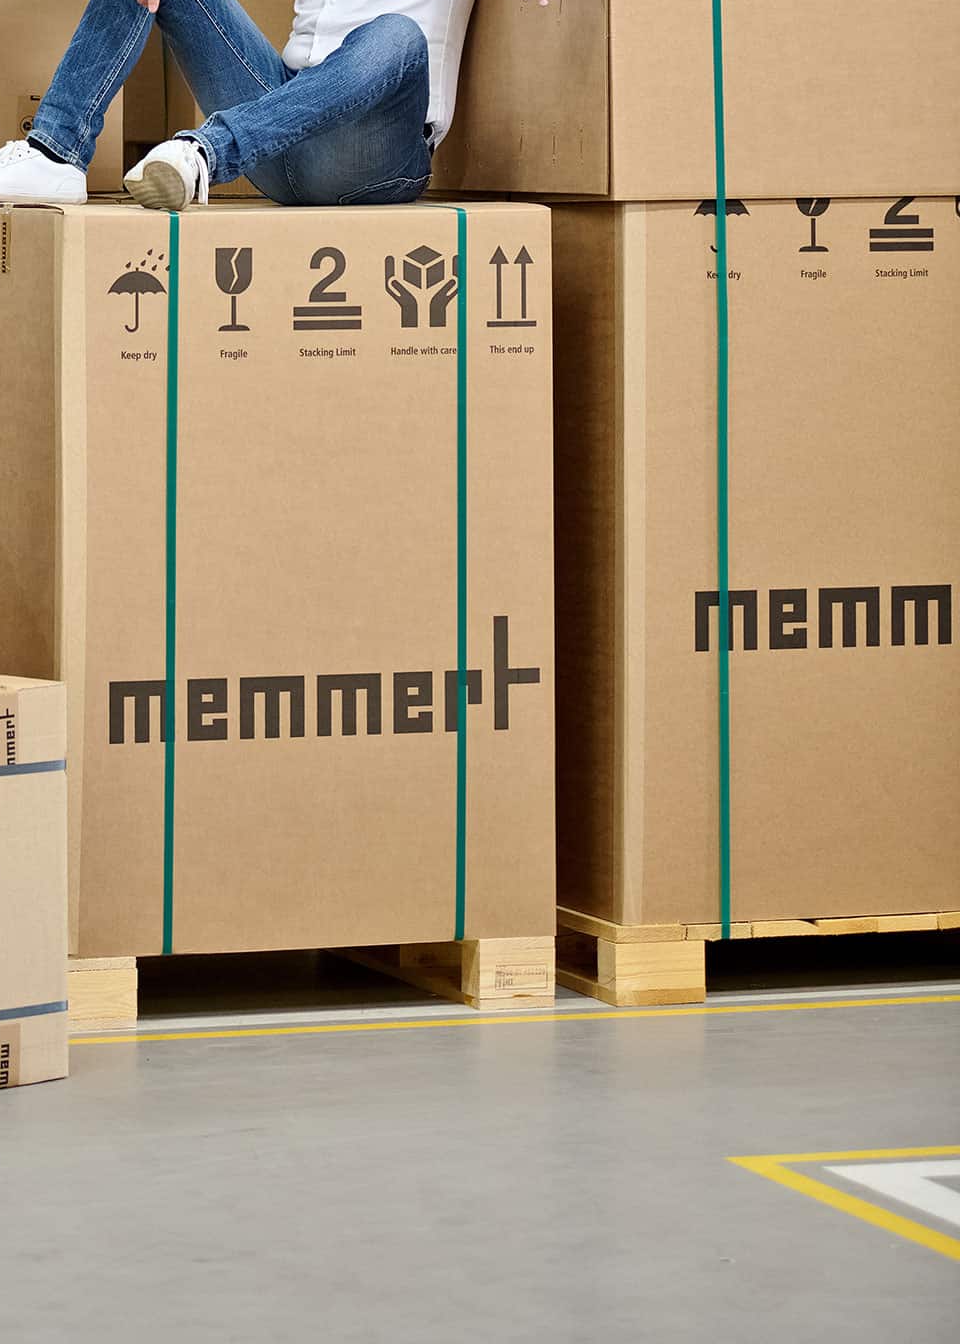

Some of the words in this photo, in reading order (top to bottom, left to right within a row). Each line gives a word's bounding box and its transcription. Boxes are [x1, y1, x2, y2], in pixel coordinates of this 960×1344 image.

[309, 247, 347, 303] 2
[728, 270, 741, 281] dry
[800, 269, 827, 280] Fragile
[875, 268, 908, 280] Stacking
[909, 268, 929, 278] Limit
[121, 350, 142, 361] Keep
[143, 350, 158, 362] dry
[219, 348, 248, 360] Fragile
[299, 347, 333, 359] Stacking
[335, 347, 356, 357] Limit
[390, 346, 419, 356] Handle
[420, 346, 439, 355] with
[440, 347, 457, 355] care
[489, 344, 506, 354] This
[507, 344, 522, 354] end
[524, 345, 535, 356] up
[695, 584, 952, 652] memm
[109, 615, 541, 745] memmert
